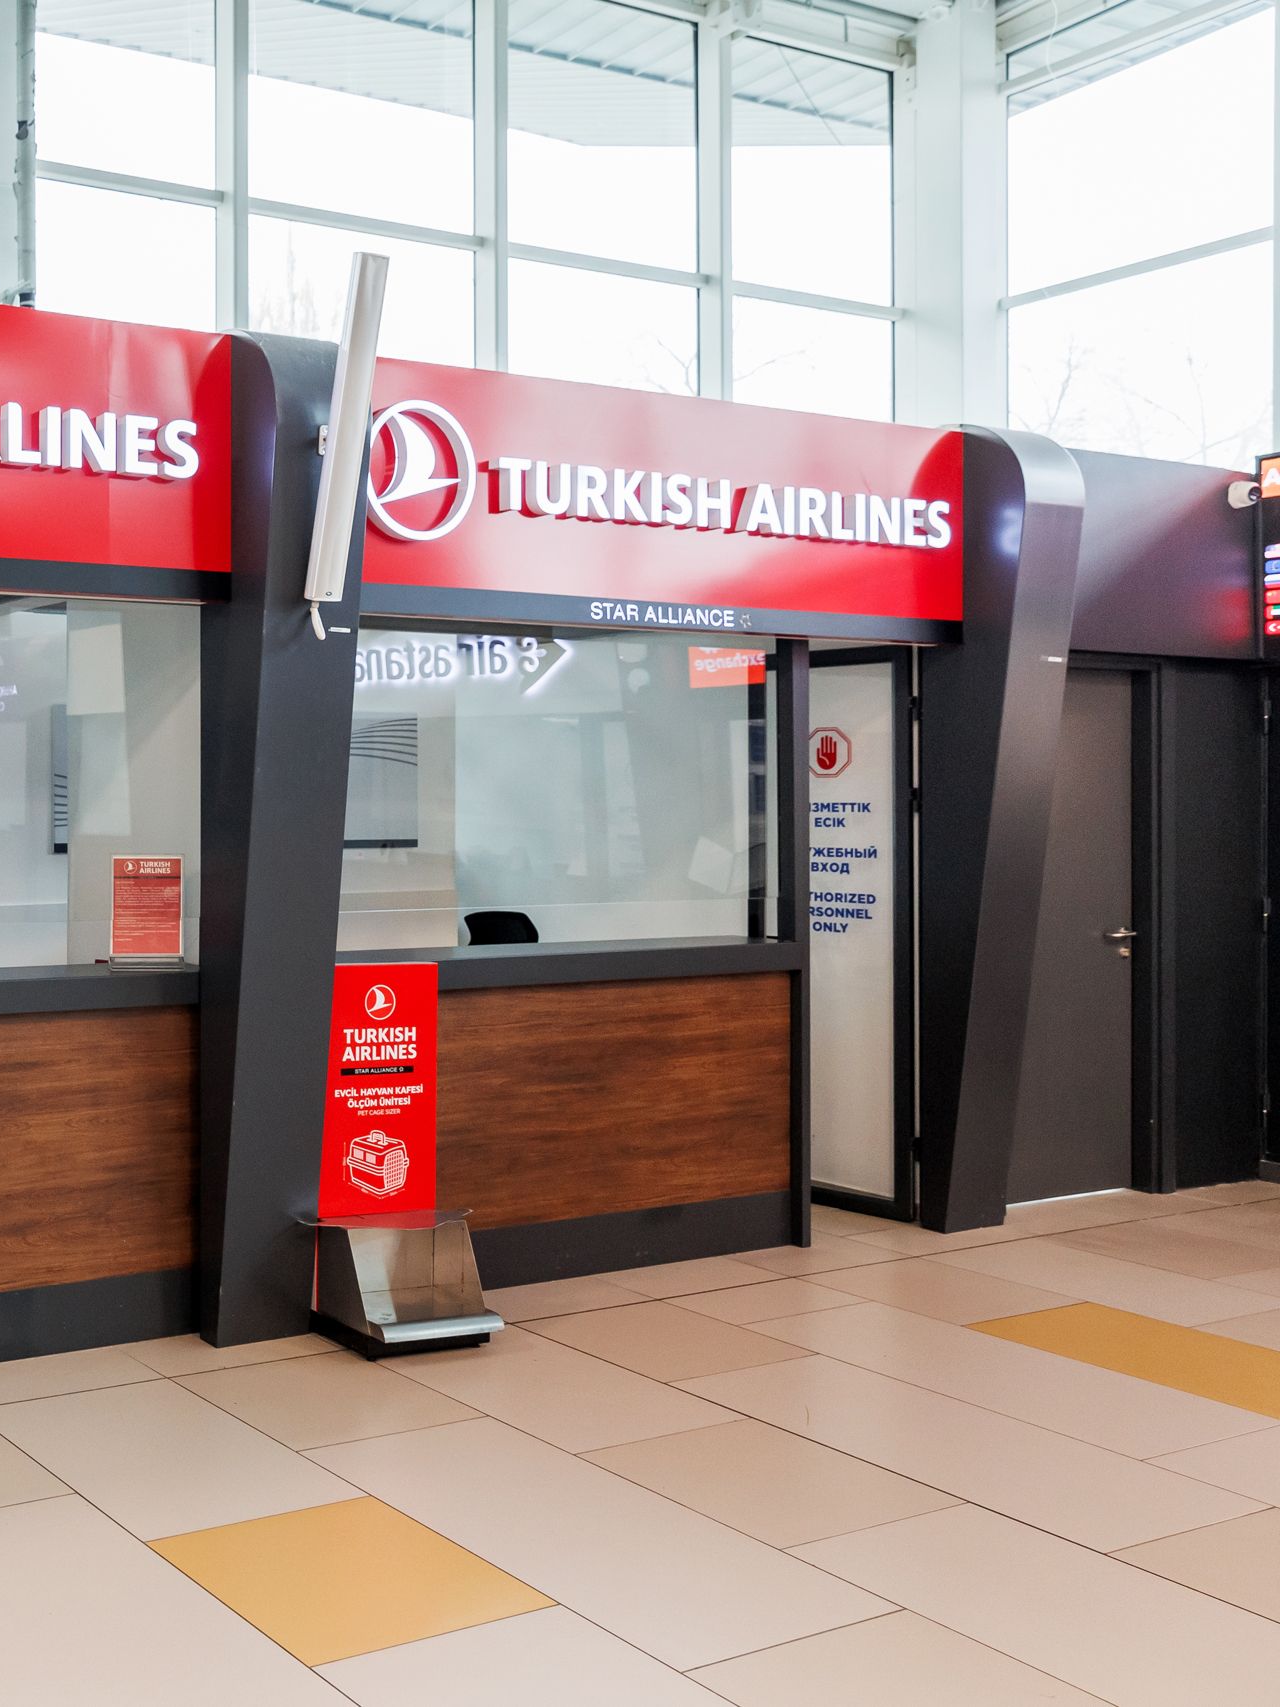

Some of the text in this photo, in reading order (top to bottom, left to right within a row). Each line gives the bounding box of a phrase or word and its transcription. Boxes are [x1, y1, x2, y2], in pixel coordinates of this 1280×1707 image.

[499, 456, 952, 549] TURKISH AIRLINES
[590, 601, 735, 627] STAR ALLIANCE
[809, 802, 871, 813] ЗМЕТТІК
[814, 817, 846, 827] ЕСІК
[809, 846, 877, 858] ЖЕБНЫЙ
[810, 862, 850, 874] ВХОД
[812, 922, 848, 933] ONLY
[343, 1026, 417, 1044] TURKISH
[342, 1044, 417, 1062] AIRLINES
[334, 1083, 423, 1098] EVCİL HAYVAN KAFESİ
[347, 1098, 377, 1109] ÖLÇÜM
